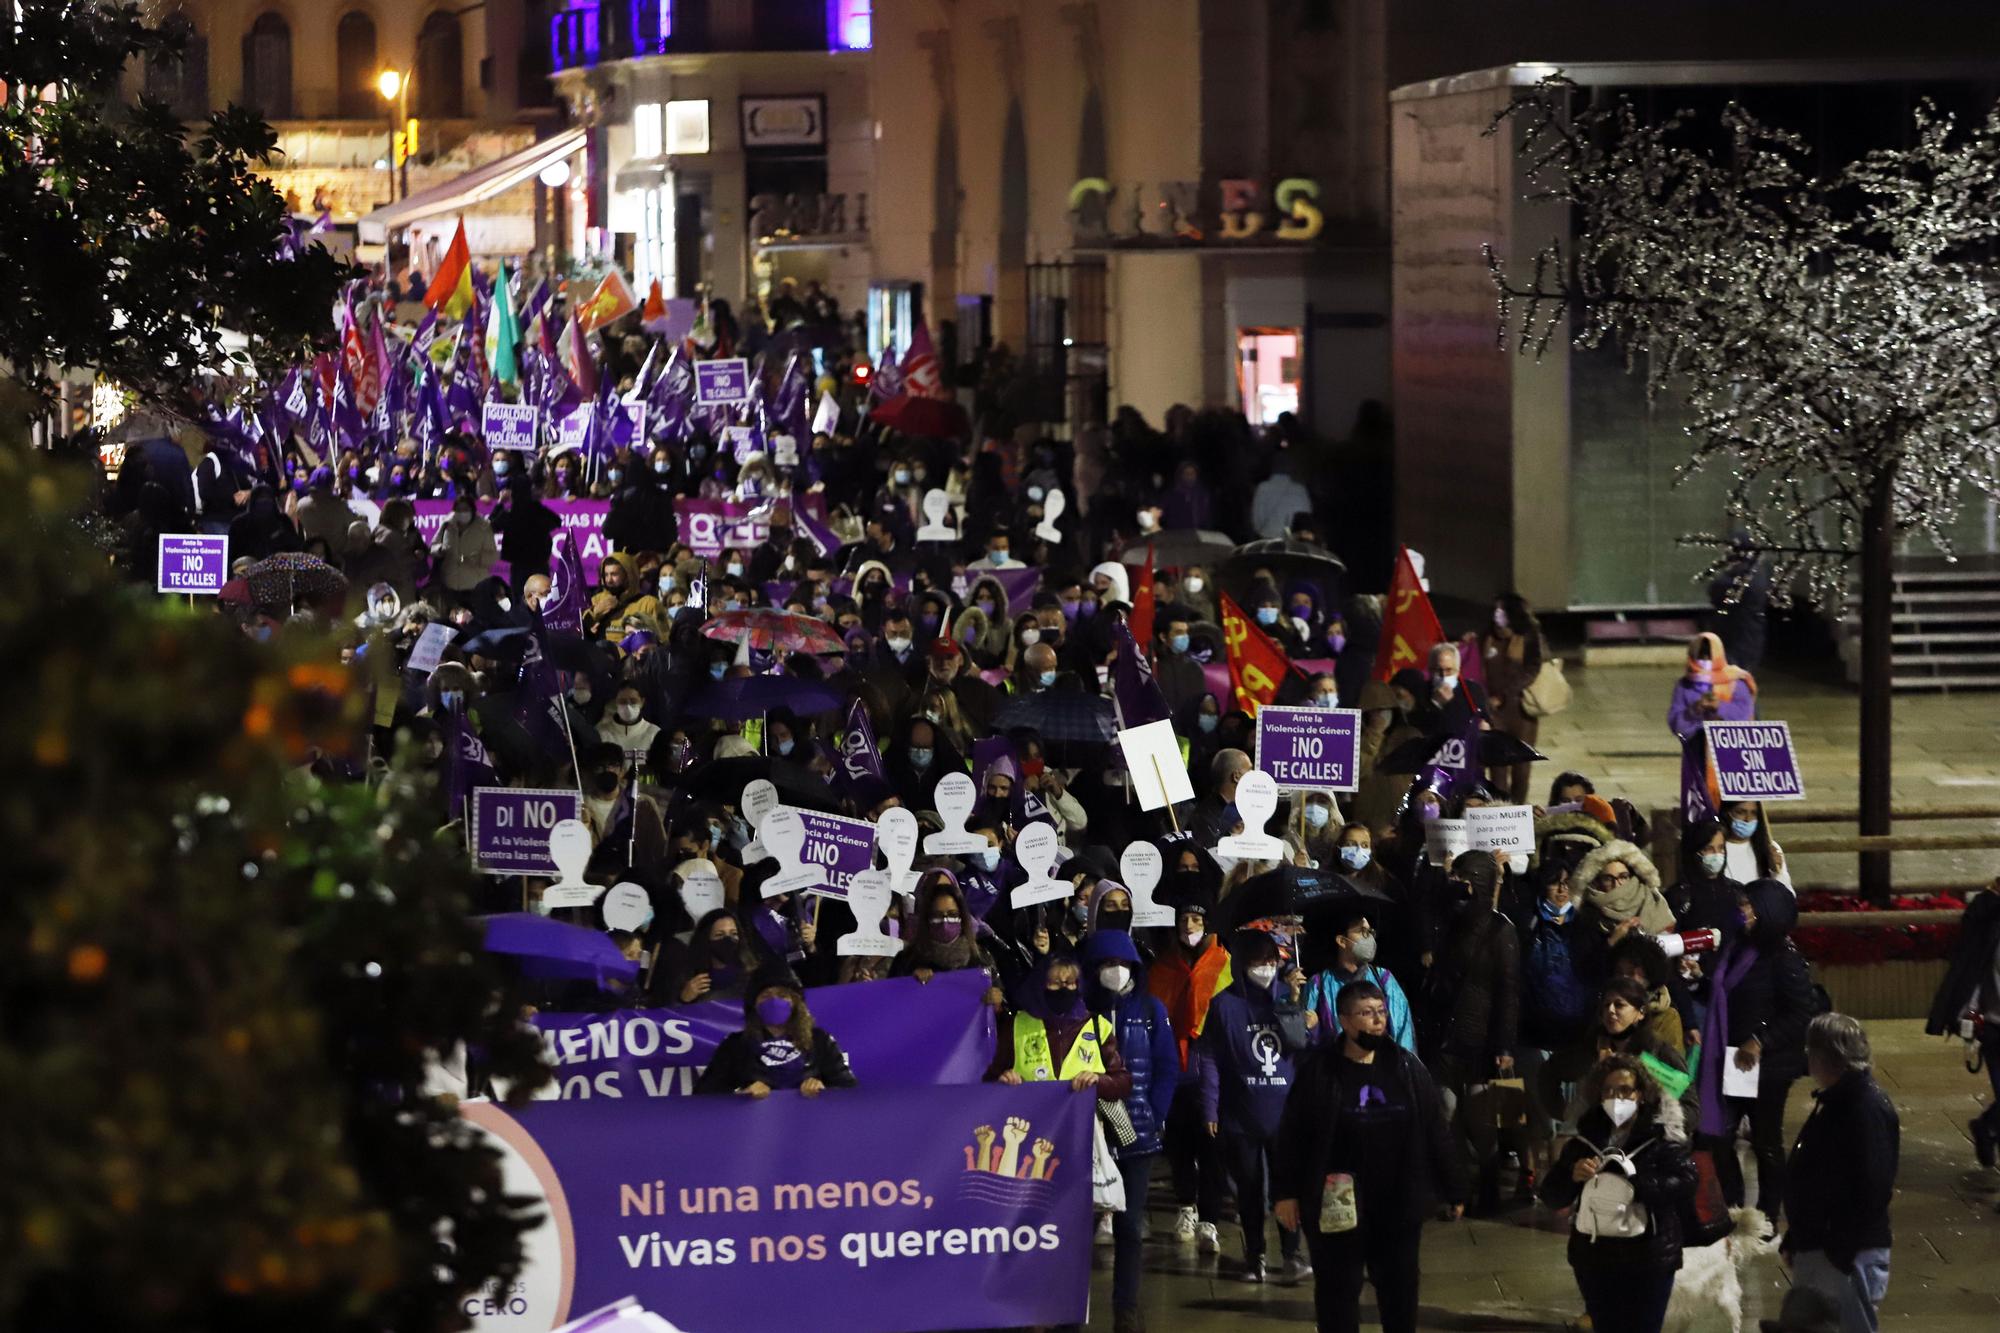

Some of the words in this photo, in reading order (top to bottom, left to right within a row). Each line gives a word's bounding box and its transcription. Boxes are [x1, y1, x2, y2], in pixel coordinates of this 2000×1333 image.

[487, 407, 532, 421] IGUALDAD
[502, 419, 517, 432] SIN
[486, 431, 532, 446] VIOLENCIA
[182, 555, 203, 571] ¡NO
[169, 572, 181, 586] TE
[182, 573, 217, 586] CALLES!
[1292, 714, 1313, 723] Ante
[1315, 714, 1323, 723] la
[1265, 724, 1305, 733] Violencia
[1306, 726, 1317, 734] de
[1319, 726, 1351, 736] Género
[1712, 728, 1784, 749] IGUALDAD
[1292, 736, 1323, 759] ¡NO
[1741, 750, 1766, 770] SIN
[1272, 761, 1288, 778] TE
[1291, 761, 1343, 781] CALLES!
[1721, 771, 1797, 793] VIOLENCIA
[496, 806, 514, 828] DI
[524, 800, 557, 829] NO
[1499, 811, 1528, 819] MUJER
[810, 818, 831, 829] Ante
[832, 821, 841, 831] la
[492, 837, 500, 845] A
[502, 837, 512, 846] la
[512, 837, 551, 847] Violenc
[823, 831, 835, 841] de
[836, 835, 869, 848] Género
[1490, 837, 1519, 846] SERLO
[480, 851, 513, 860] contra
[514, 851, 529, 860] las
[806, 839, 840, 866] ¡NO
[618, 1180, 666, 1217] Ni
[679, 1183, 759, 1214] una
[773, 1178, 934, 1211] menos,
[618, 1232, 736, 1269] Vivas
[750, 1233, 827, 1263] nos
[840, 1222, 1060, 1268] queremos
